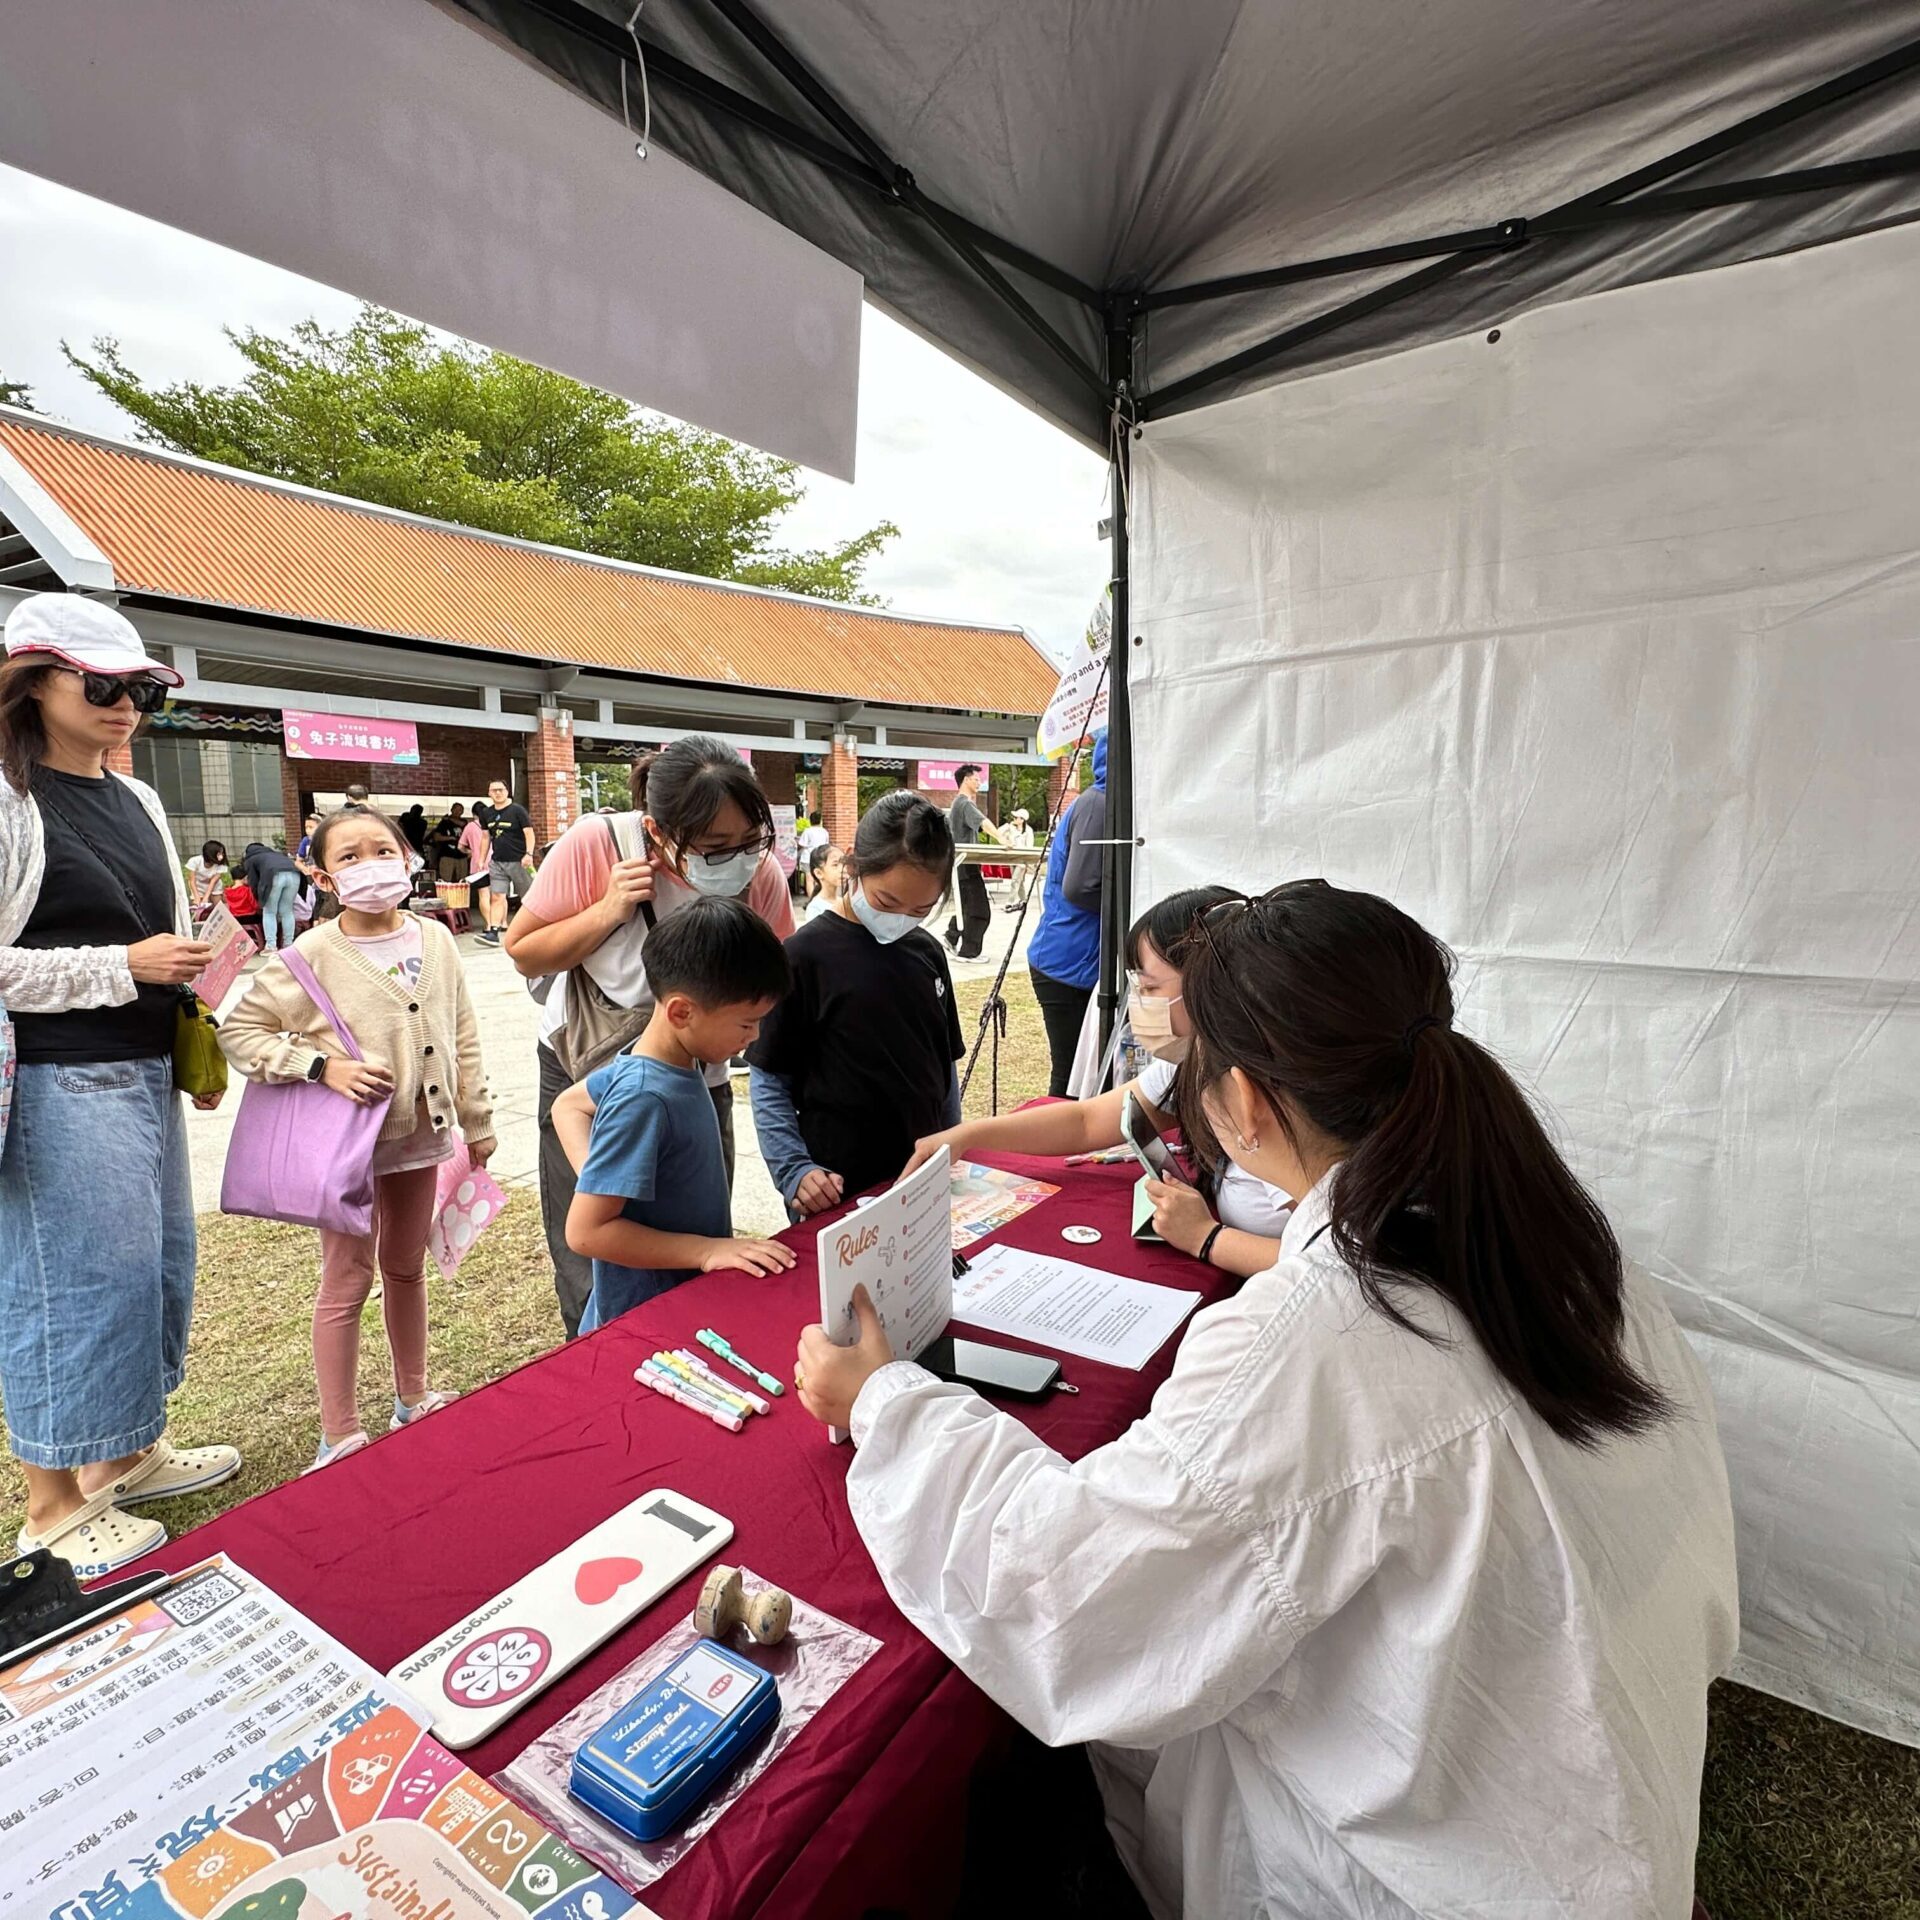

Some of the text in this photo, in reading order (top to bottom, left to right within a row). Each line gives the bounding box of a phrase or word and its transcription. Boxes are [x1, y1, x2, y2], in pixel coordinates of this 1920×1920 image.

[1078, 660, 1094, 677] and
[309, 730, 396, 751] 兔子流域書坊
[836, 1225, 879, 1268] Rules
[642, 1498, 715, 1542] I
[73, 1563, 109, 1576] ocs
[155, 1568, 215, 1603] Scan for More
[65, 1623, 126, 1658] YT教學
[207, 1618, 281, 1666] 步驟三
[222, 1630, 299, 1681] 的問題
[399, 1597, 513, 1681] mangoSTEEMS
[56, 1644, 136, 1688] 更多玩法
[245, 1648, 320, 1700] 步驟二
[660, 1671, 692, 1700] Brand
[233, 1662, 339, 1733] 往左邊走
[289, 1681, 364, 1736] 步驟一
[624, 1702, 692, 1763] Stamp Pad
